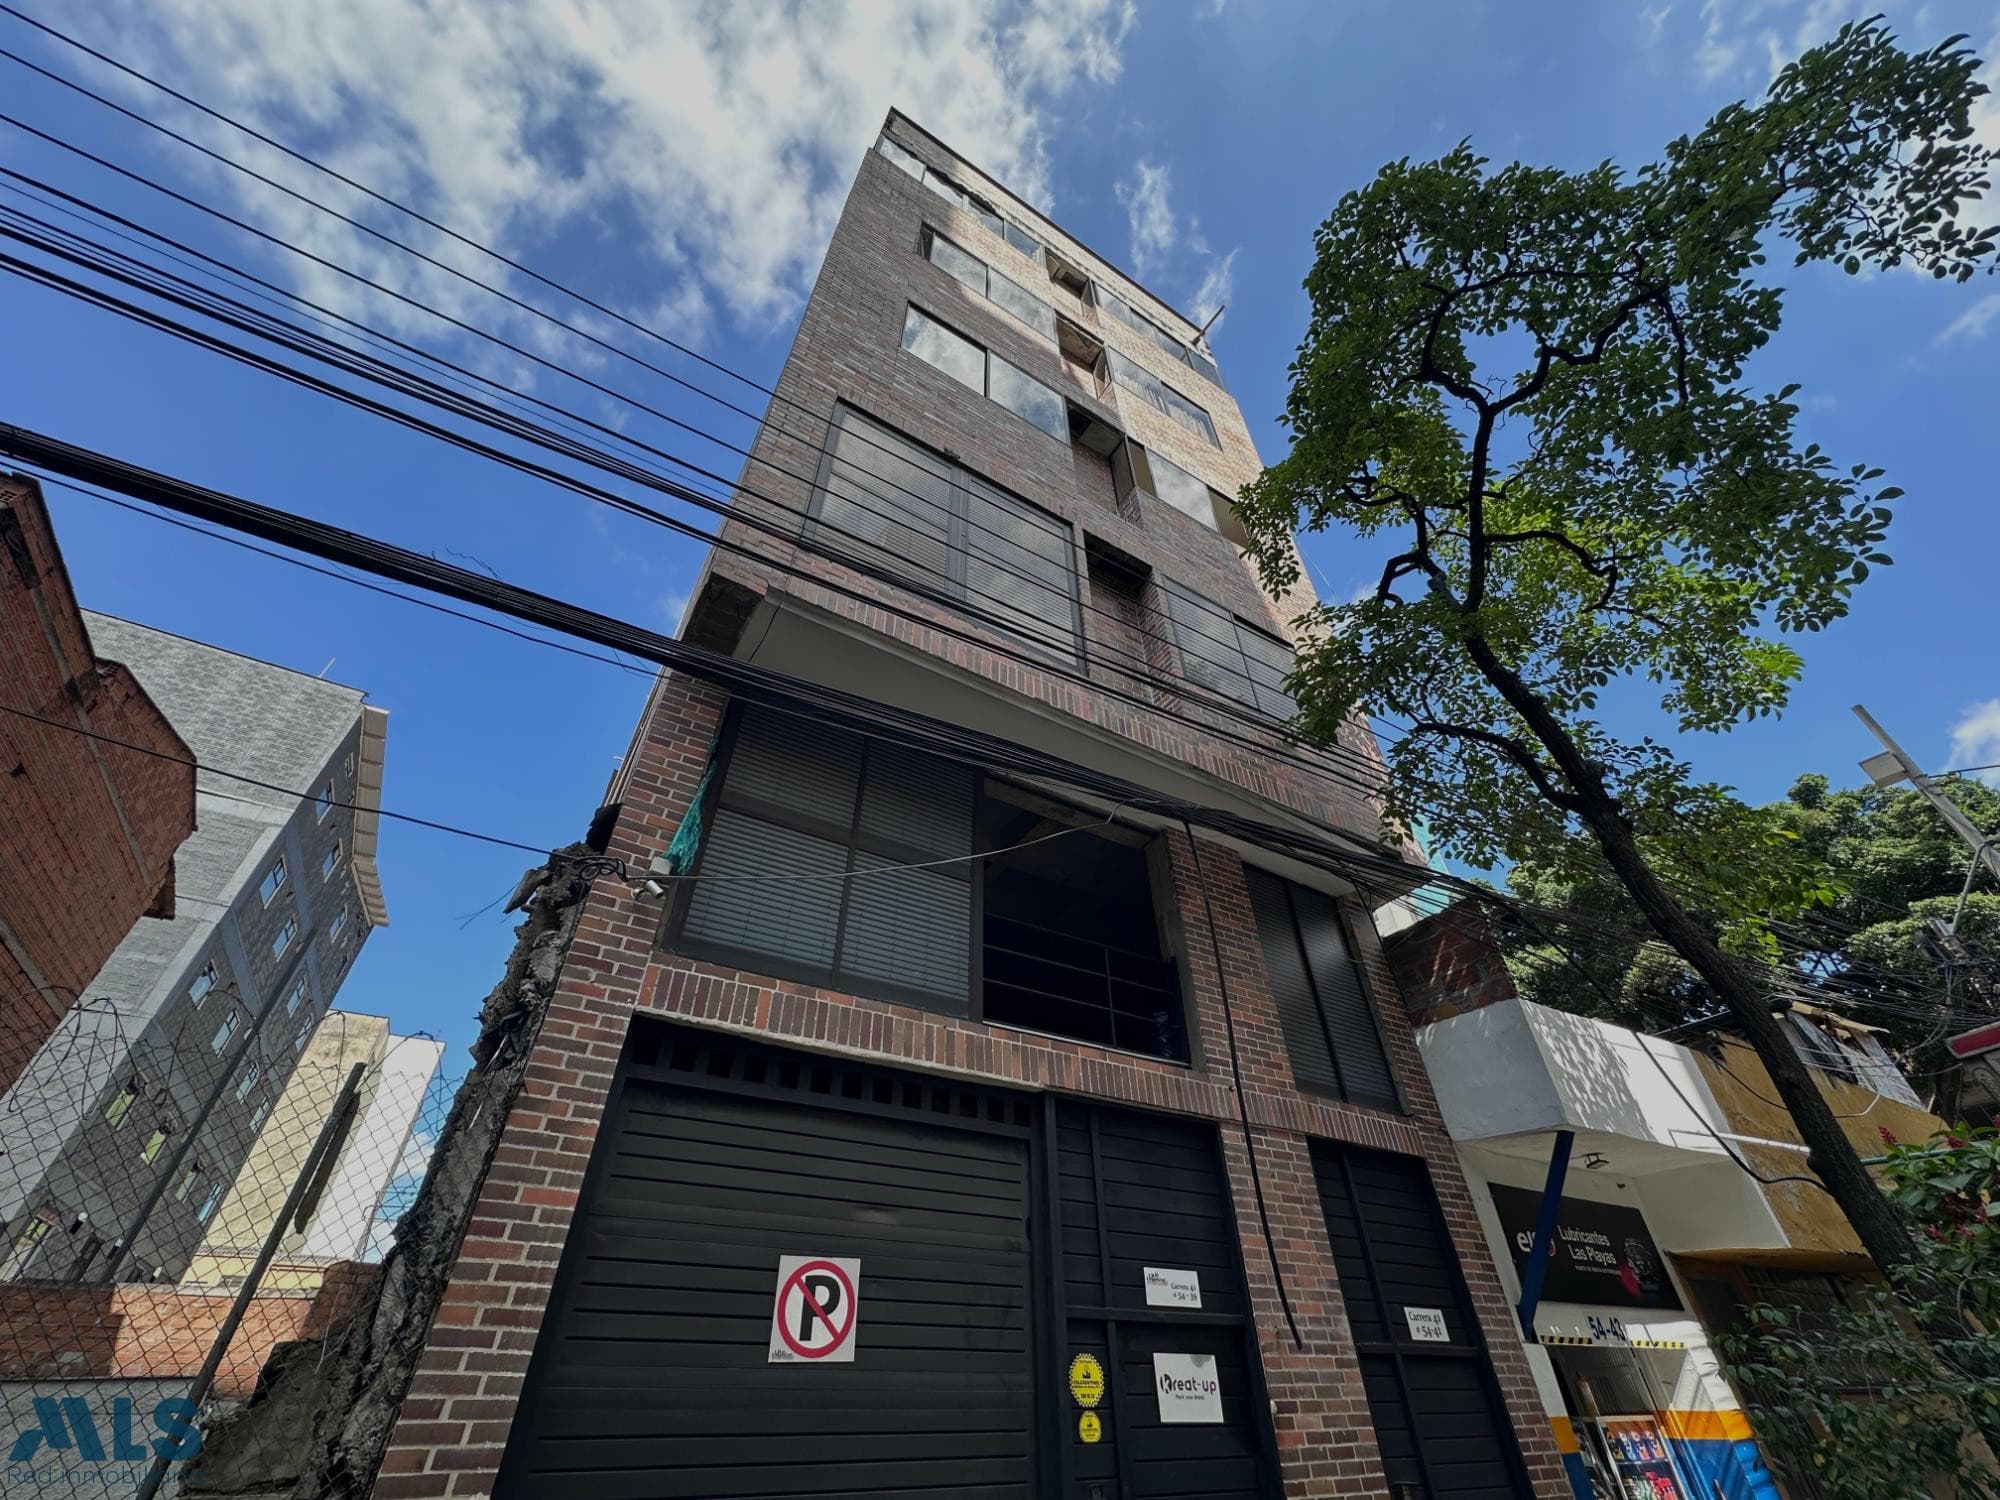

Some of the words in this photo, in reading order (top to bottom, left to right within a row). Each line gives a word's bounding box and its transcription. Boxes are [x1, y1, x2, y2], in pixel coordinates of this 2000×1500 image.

[1557, 1224, 1610, 1247] Lubricantes
[1567, 1244, 1587, 1261] Las
[1585, 1246, 1617, 1266] Playas
[799, 1275, 841, 1342] P
[1408, 1311, 1432, 1322] Carrera
[1587, 1316, 1627, 1342] 54-43
